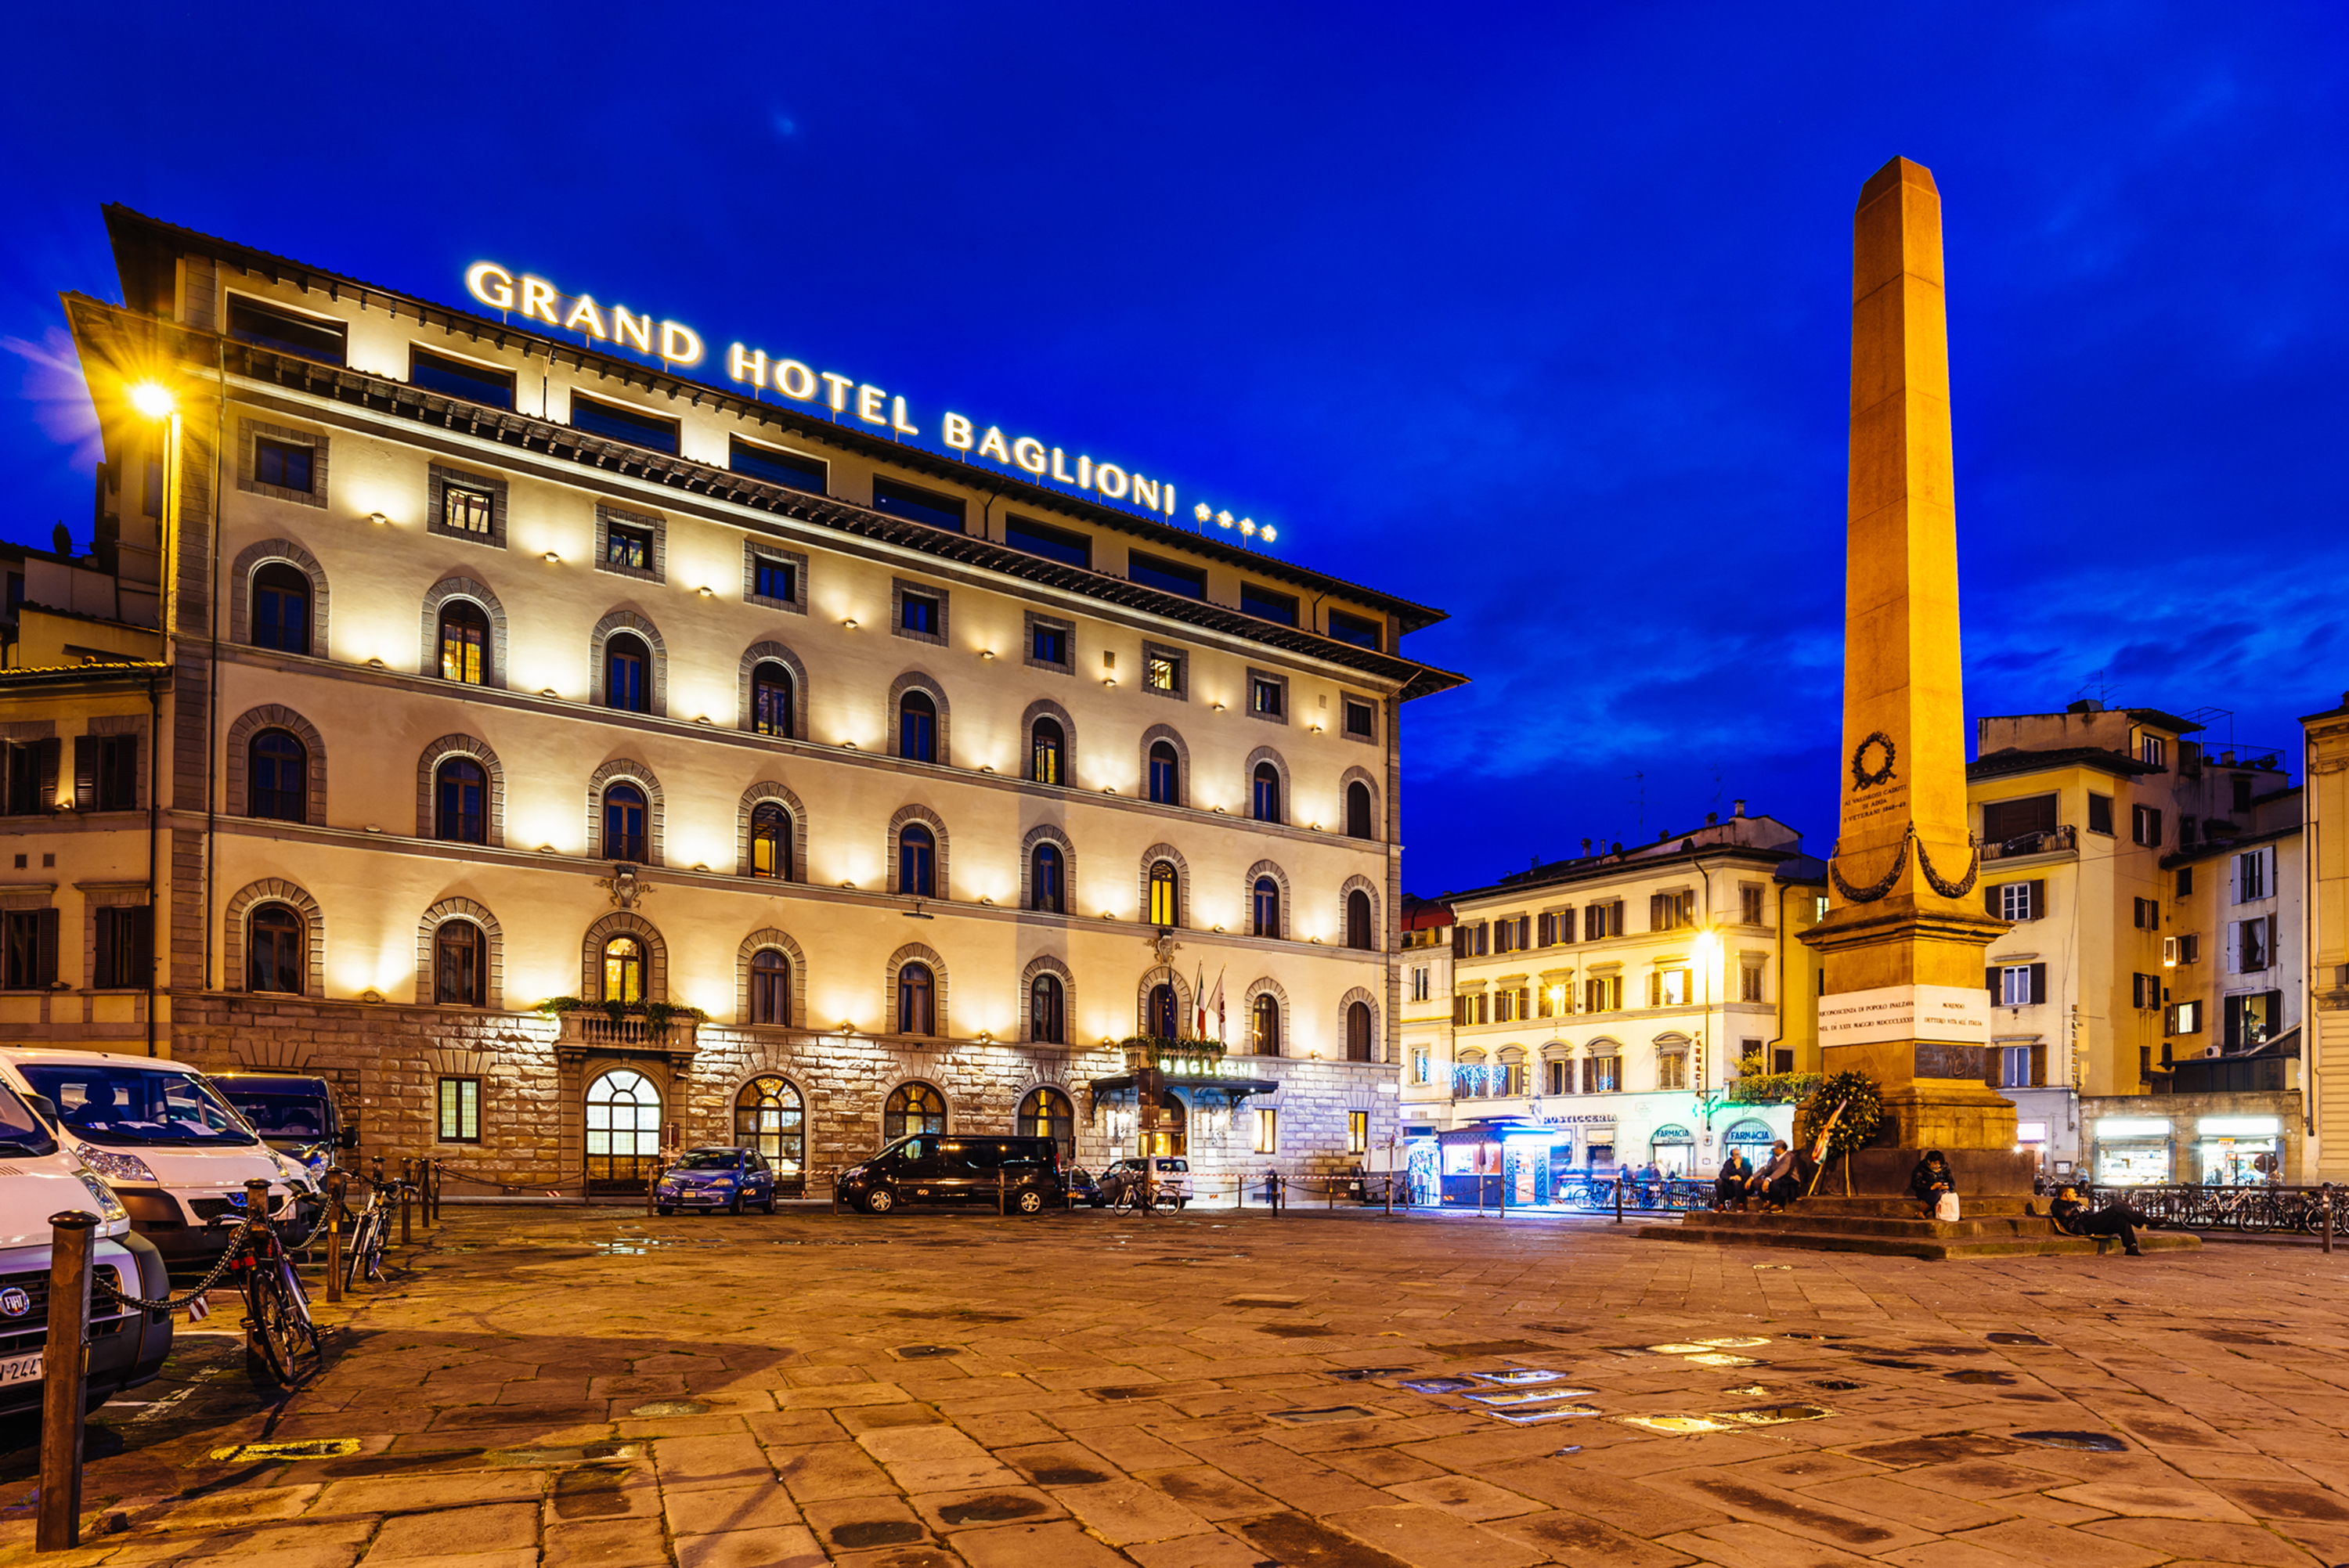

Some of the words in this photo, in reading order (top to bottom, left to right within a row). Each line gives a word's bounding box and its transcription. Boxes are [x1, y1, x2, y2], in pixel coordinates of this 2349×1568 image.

[467, 262, 701, 364] GRAND
[731, 342, 919, 435] HOTEL
[944, 411, 1174, 516] BAGLIONI
[1853, 791, 1882, 804] VALOROSI
[1871, 798, 1887, 807] ADUA
[1849, 809, 1880, 821] VETERANI
[1819, 1007, 1856, 1017] RICONOSCENZA
[1853, 1020, 1875, 1029] MAGGIO
[1159, 1058, 1258, 1077] BAGLIONI
[1543, 1114, 1618, 1124] ROSTICCERIA
[1656, 1129, 1690, 1138] FARMACIA
[1730, 1130, 1770, 1141] FARMACIA
[4, 1294, 23, 1310] FIAT
